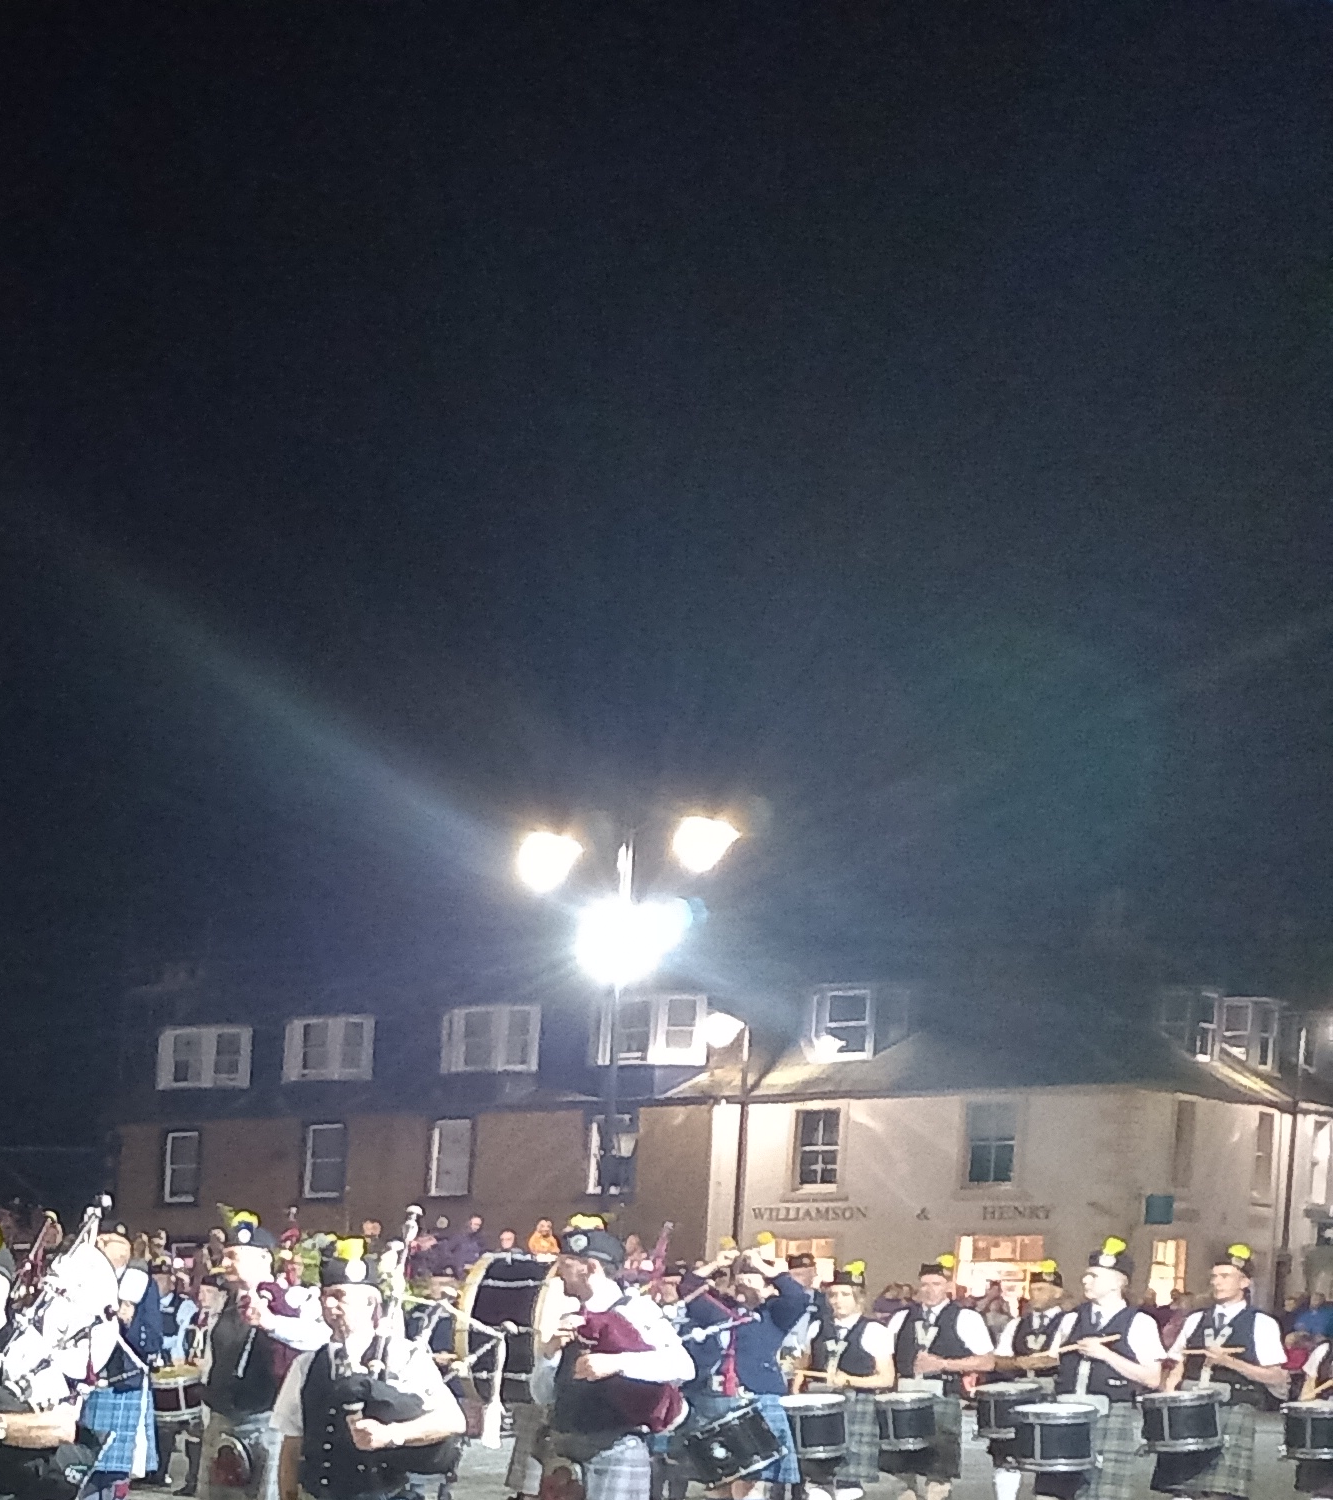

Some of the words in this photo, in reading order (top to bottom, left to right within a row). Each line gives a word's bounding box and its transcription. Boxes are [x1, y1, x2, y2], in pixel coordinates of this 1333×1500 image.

[751, 1206, 868, 1222] WILLIAMSON
[915, 1206, 930, 1221] &
[982, 1205, 1052, 1220] HENRY
